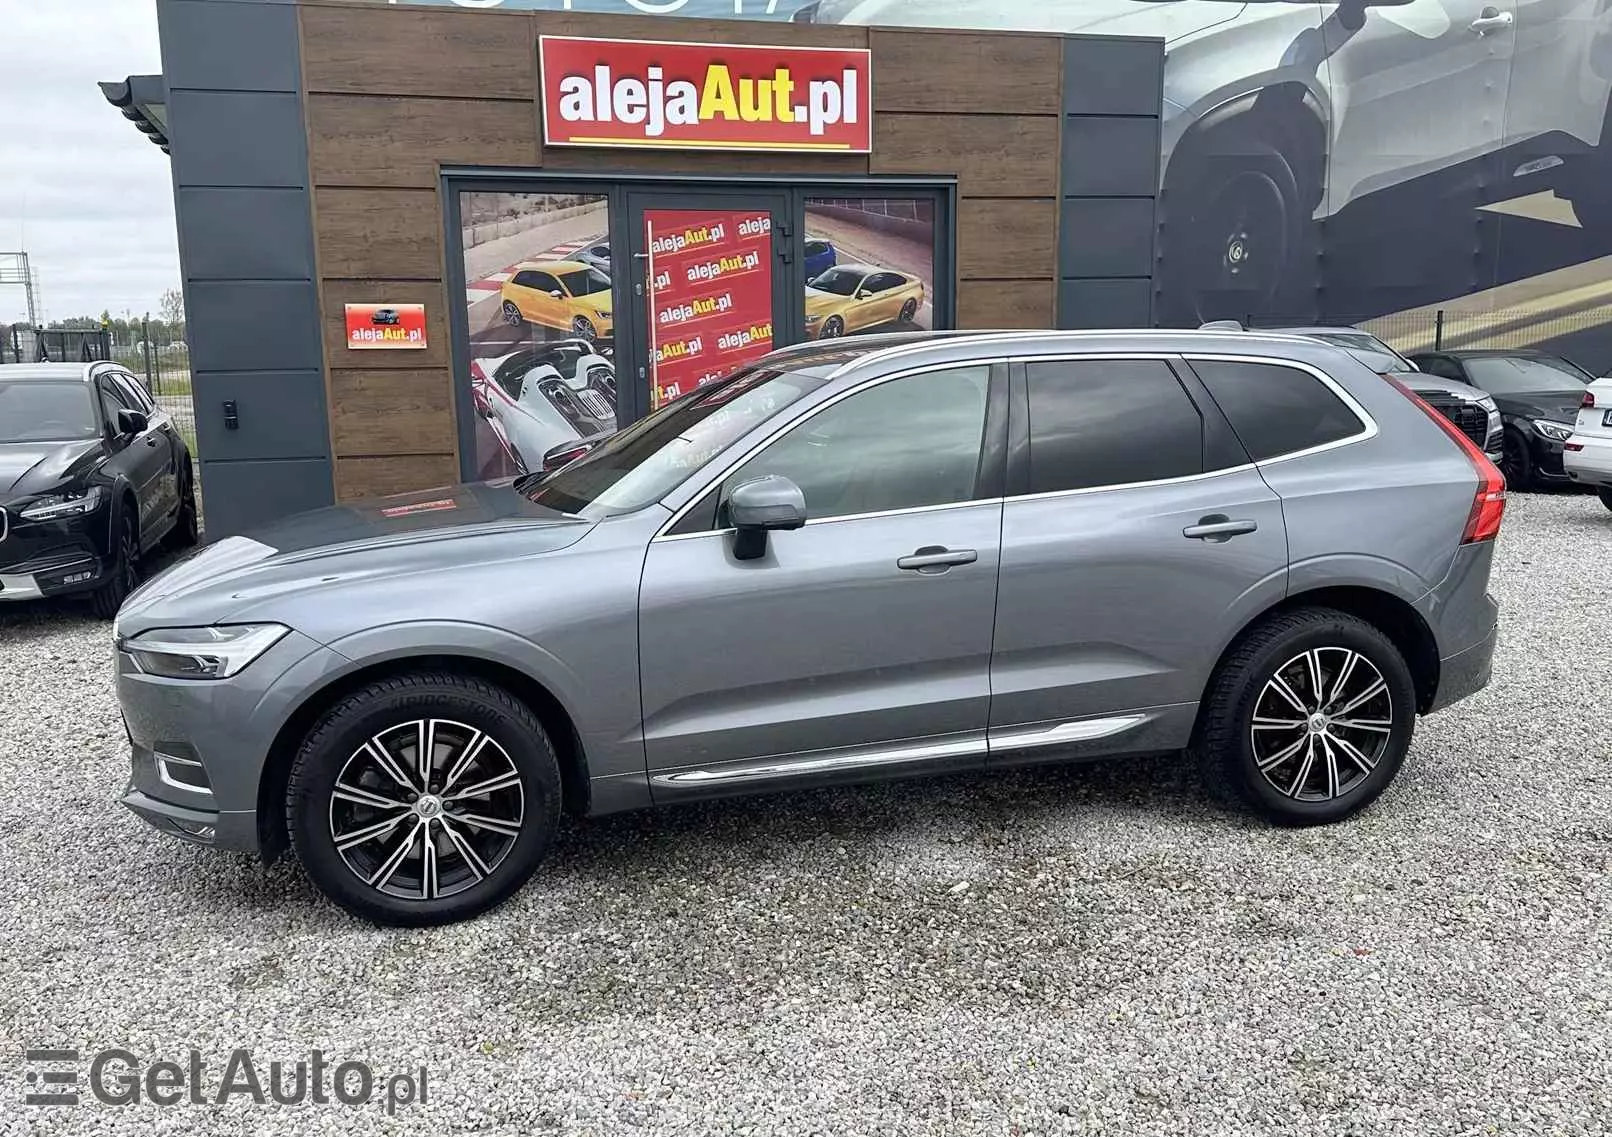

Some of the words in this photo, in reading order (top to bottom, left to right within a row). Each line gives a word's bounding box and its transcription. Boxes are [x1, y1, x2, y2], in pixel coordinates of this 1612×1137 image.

[559, 64, 857, 137] alejaAut.pl
[651, 224, 724, 253] alejaAut.pl
[687, 251, 759, 280] alejaAut.pl
[659, 294, 732, 322] alejaAut.pl
[352, 327, 422, 343] alejaAut.pl
[717, 323, 772, 349] alejaAut
